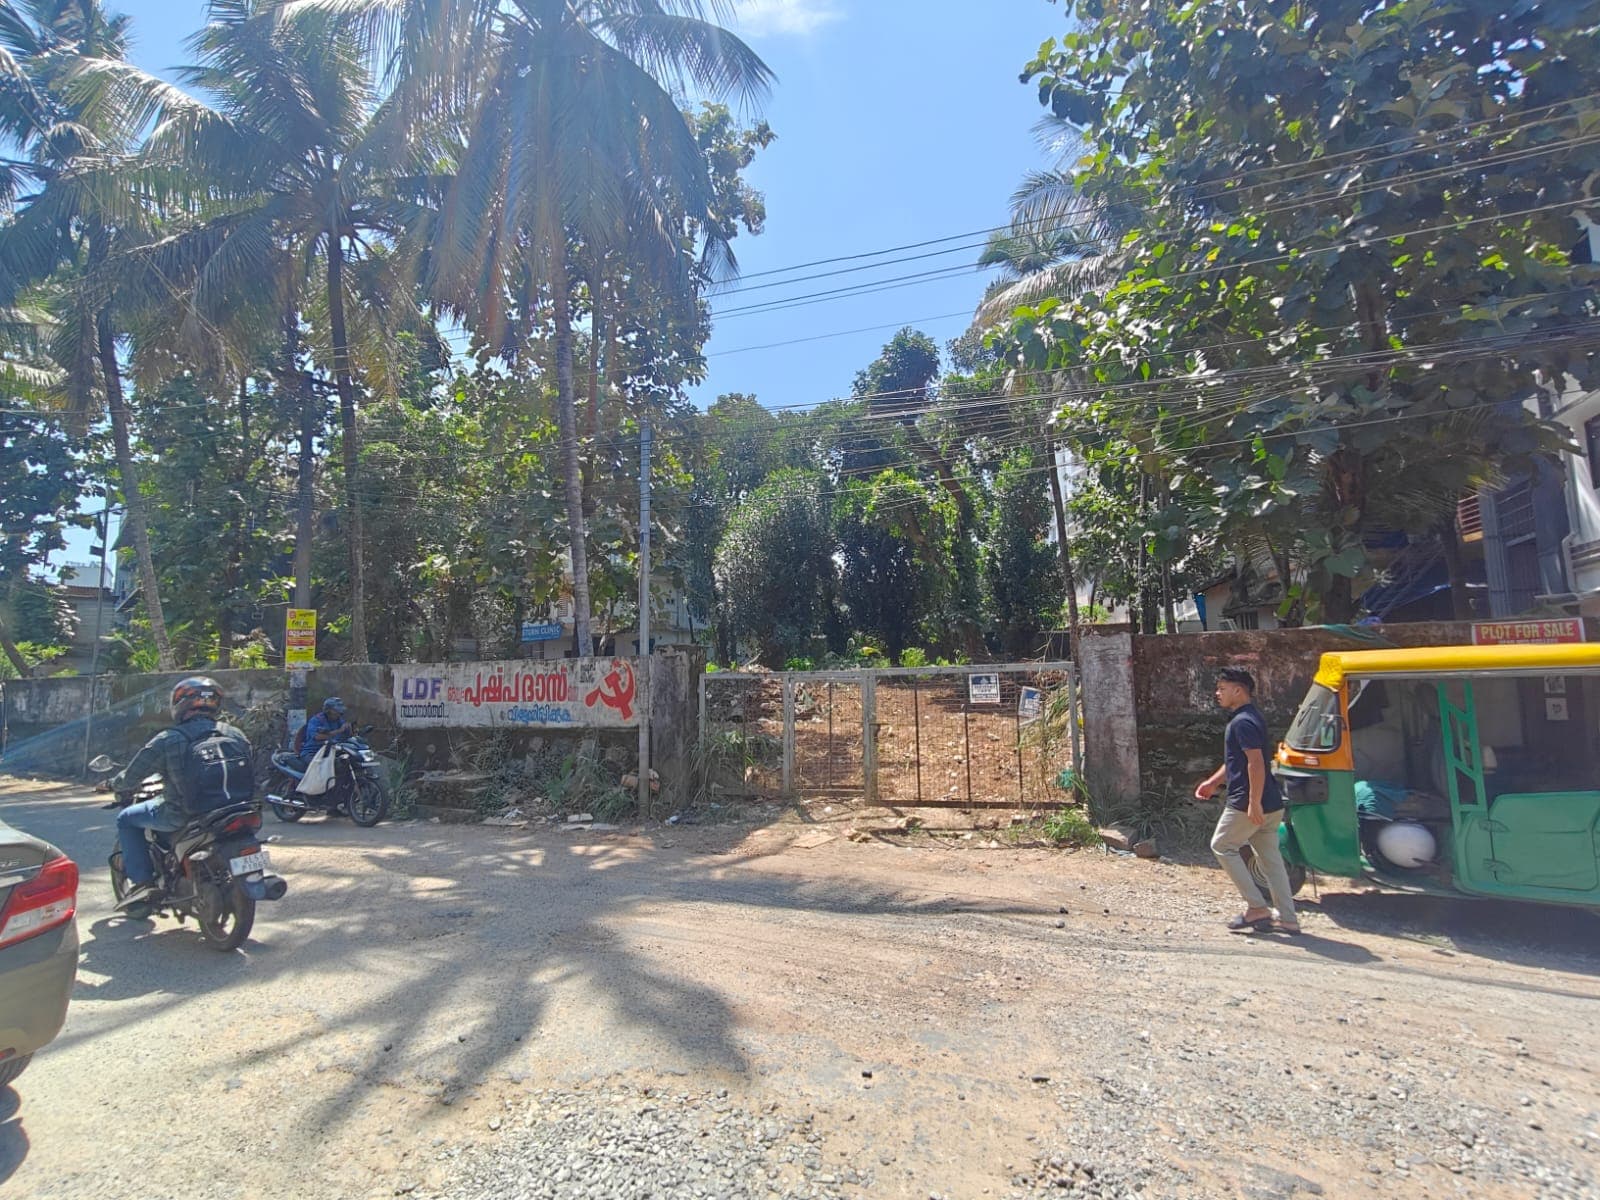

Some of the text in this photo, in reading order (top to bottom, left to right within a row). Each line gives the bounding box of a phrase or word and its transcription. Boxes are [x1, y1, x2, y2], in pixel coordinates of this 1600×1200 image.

[1481, 621, 1575, 640] PLOT FOR SALE
[402, 677, 443, 700] LDF
